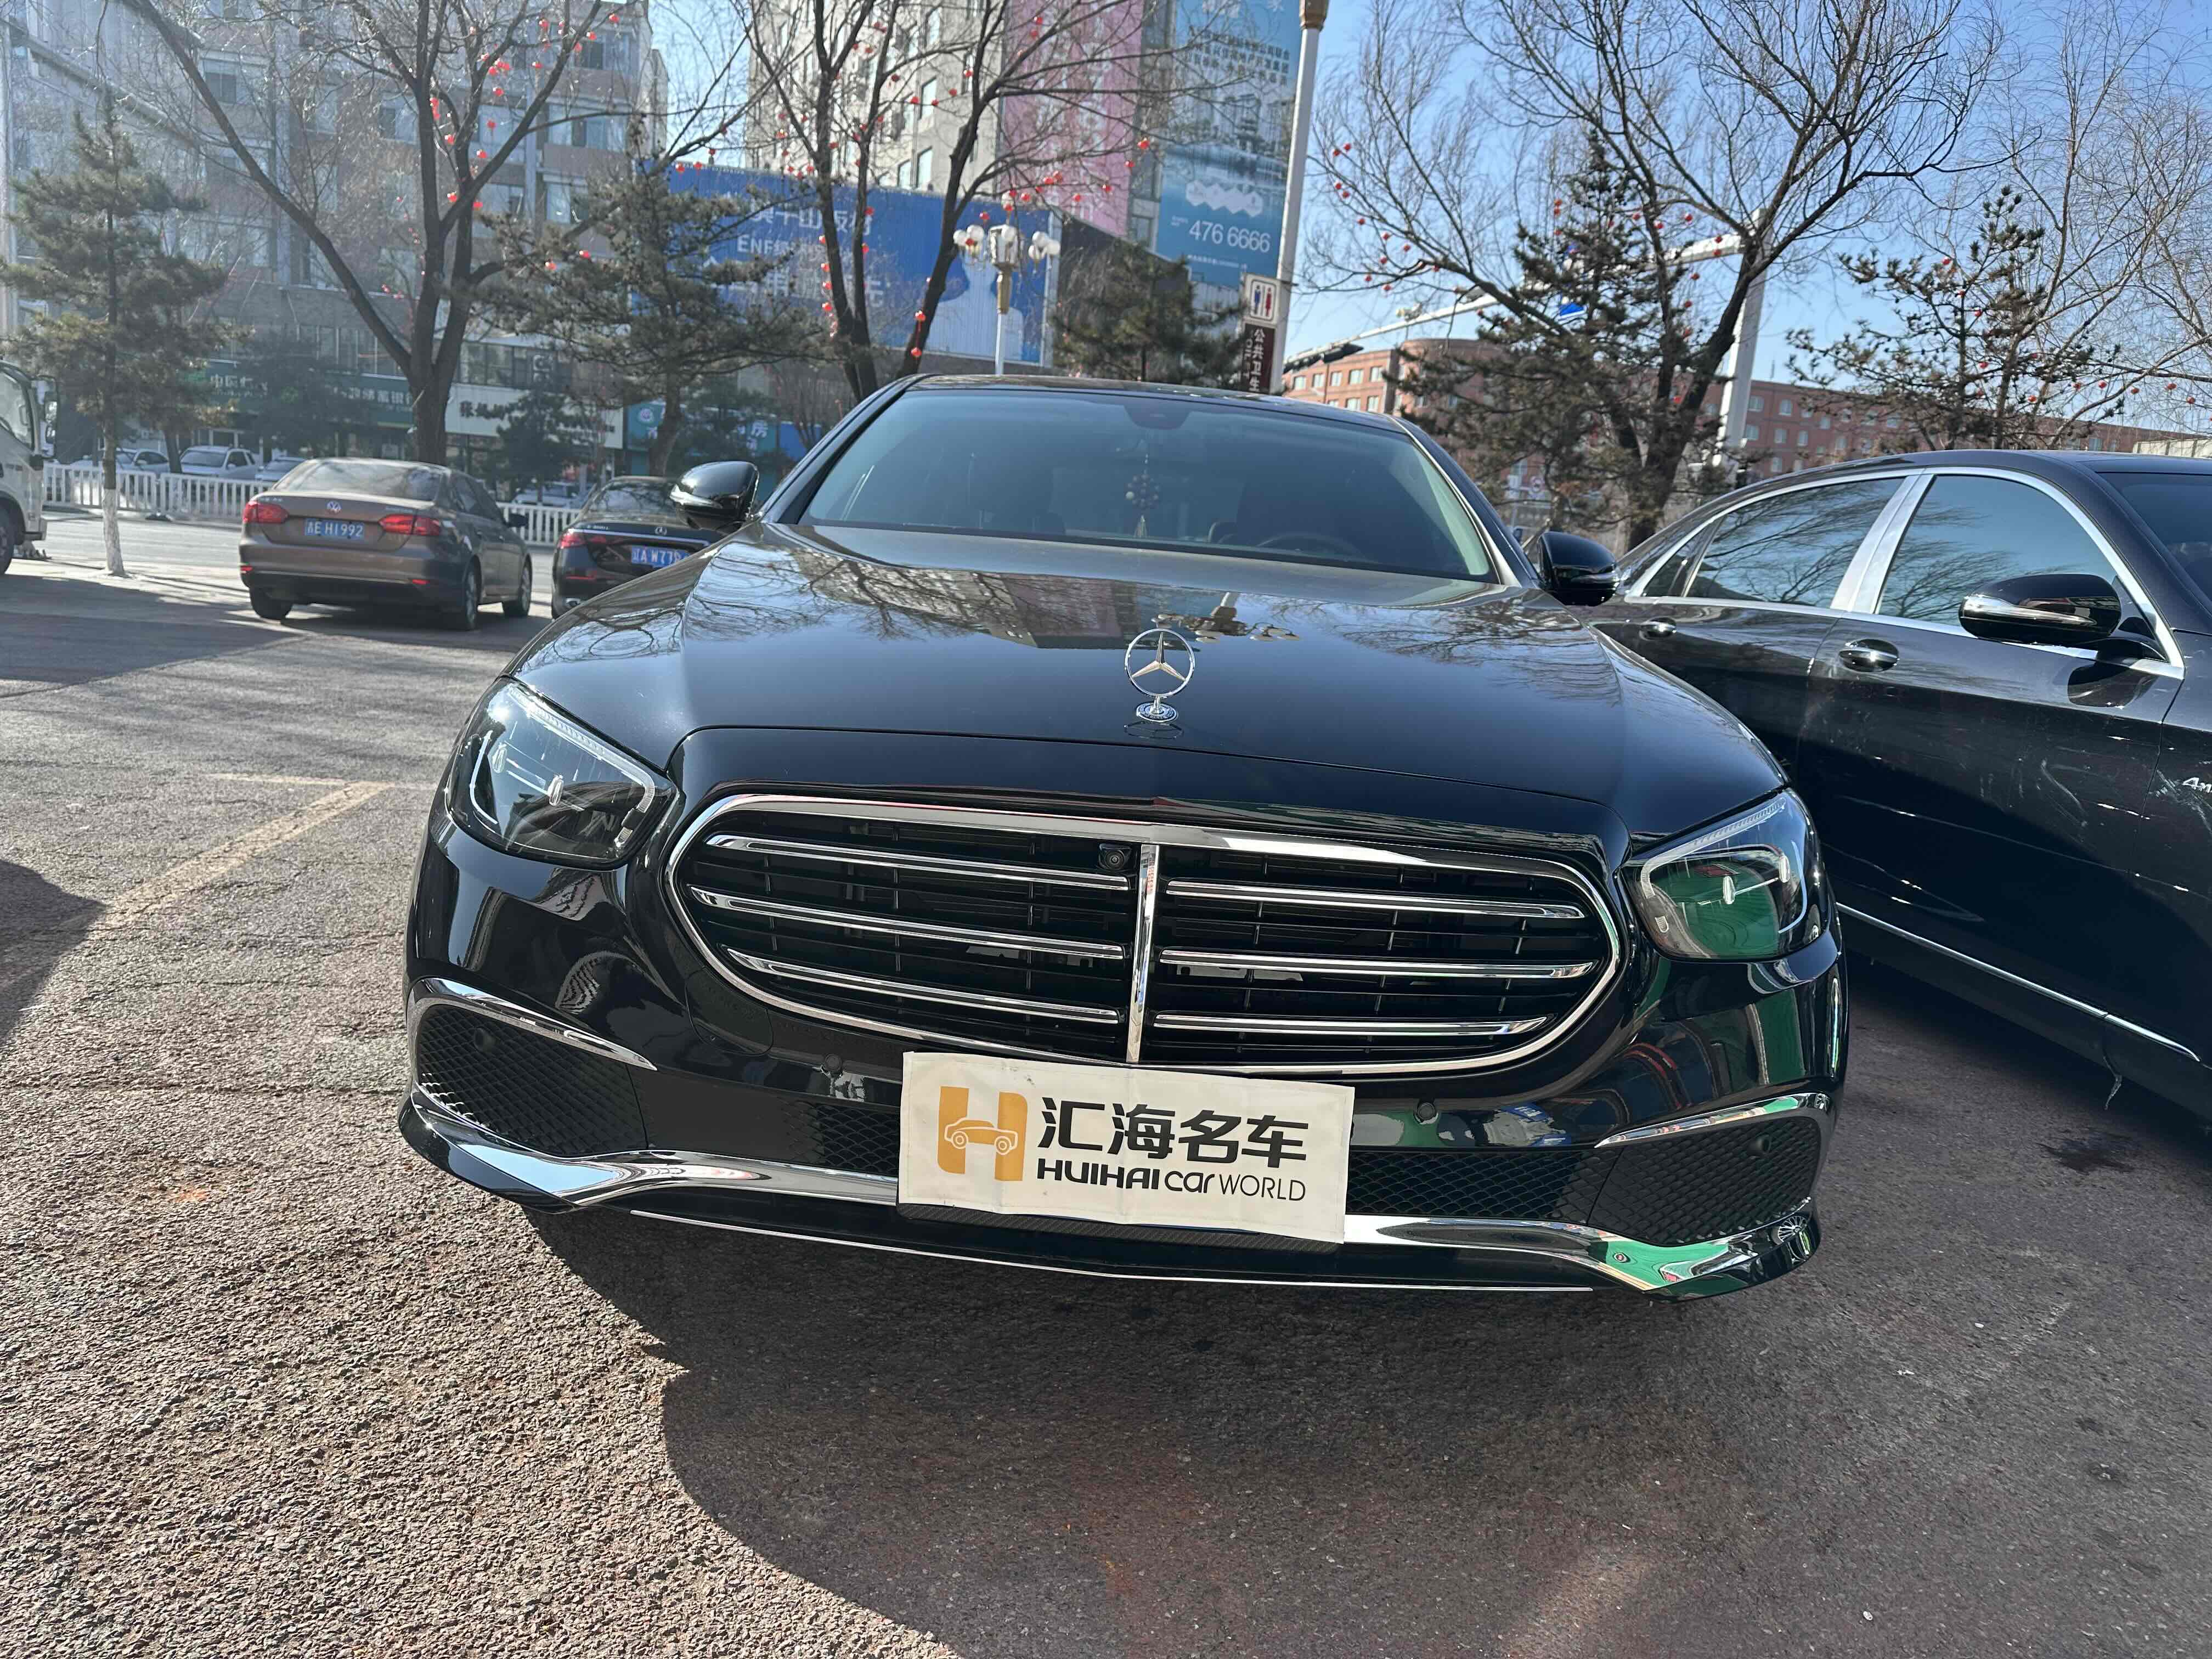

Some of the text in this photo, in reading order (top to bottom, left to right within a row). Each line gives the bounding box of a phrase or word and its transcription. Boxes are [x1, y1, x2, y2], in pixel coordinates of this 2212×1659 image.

[1189, 220, 1224, 244] 476
[1227, 226, 1271, 253] 6666
[1037, 1096, 1309, 1169] 汇海名车
[1220, 1173, 1306, 1201] WORLD
